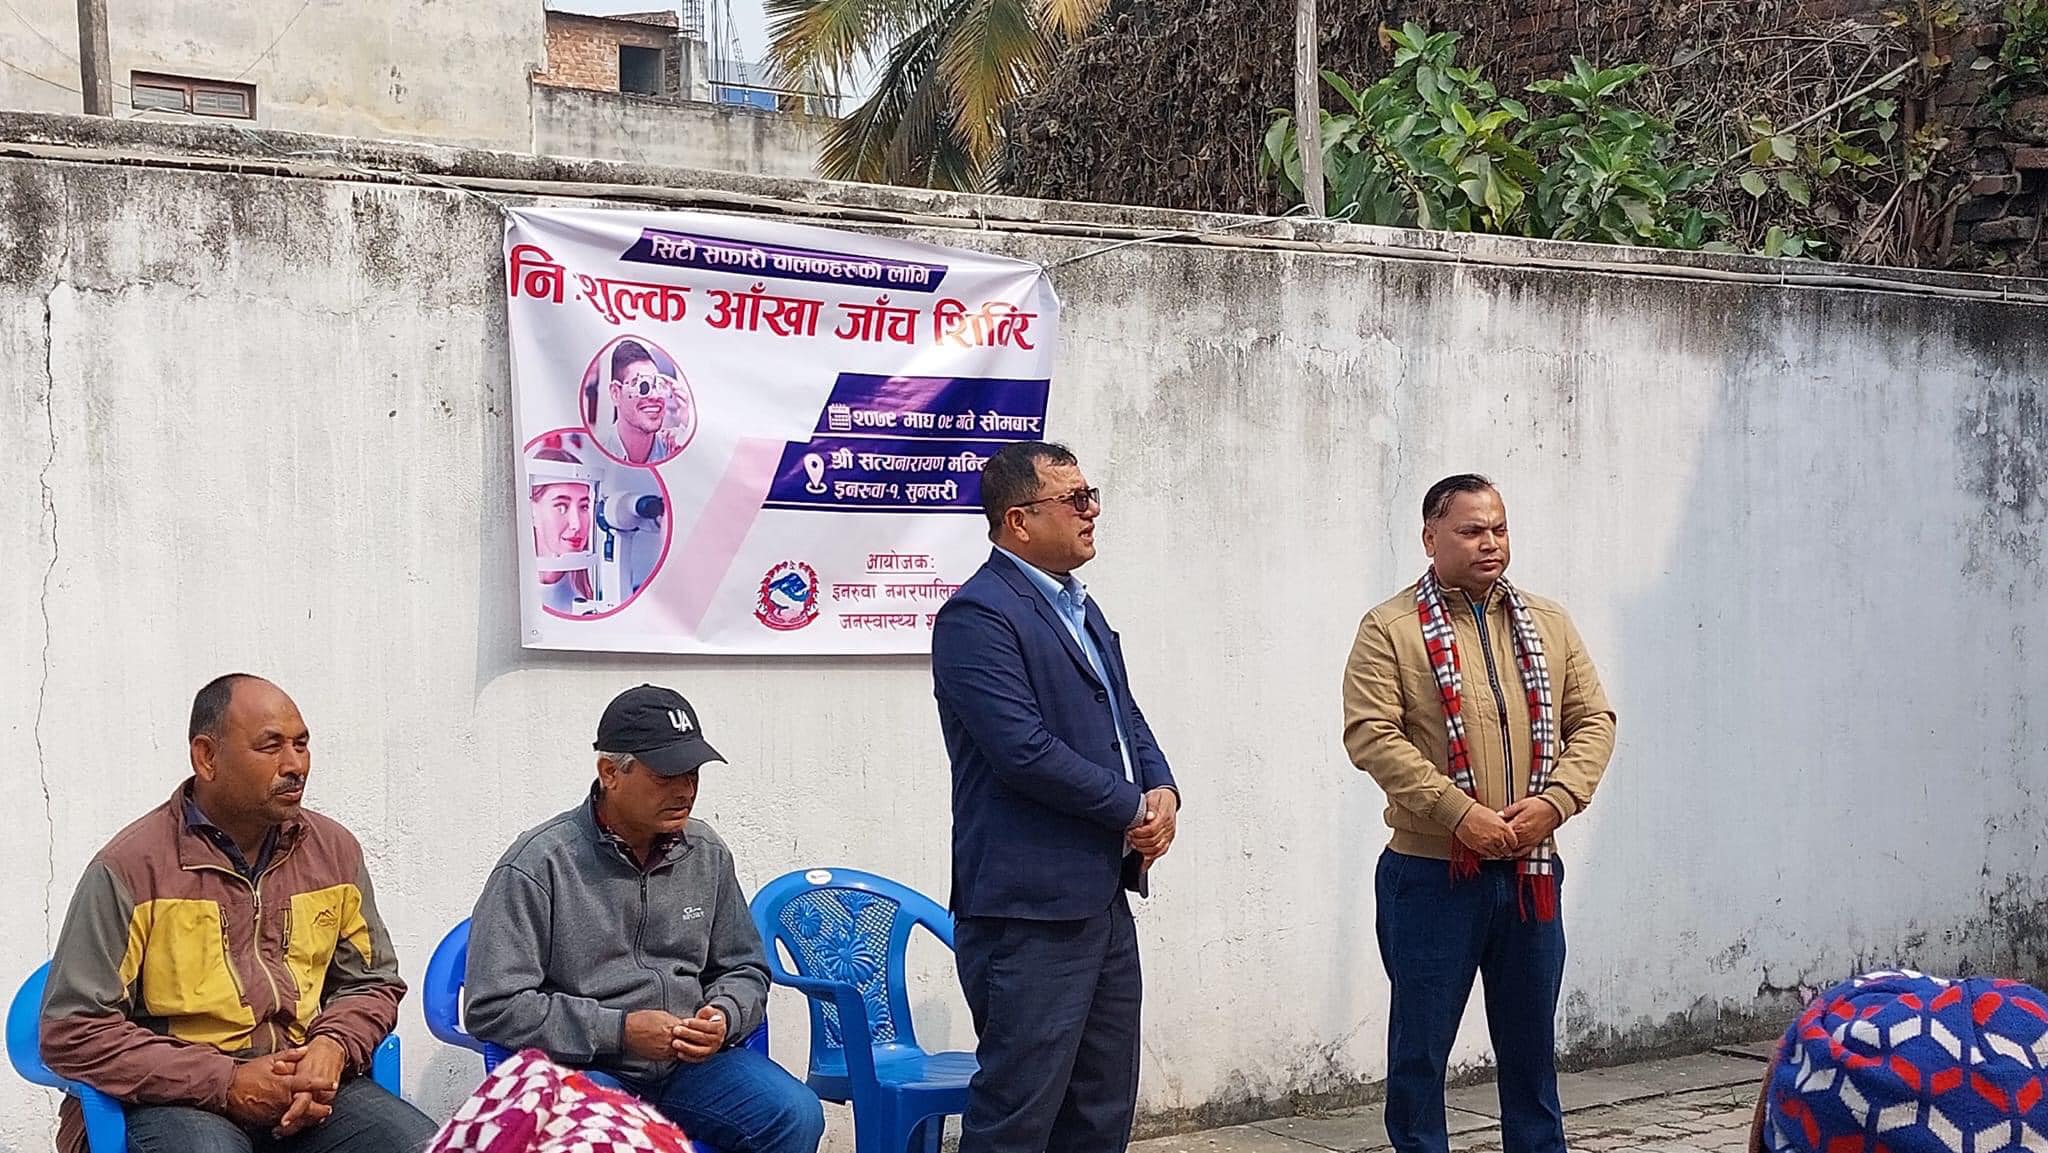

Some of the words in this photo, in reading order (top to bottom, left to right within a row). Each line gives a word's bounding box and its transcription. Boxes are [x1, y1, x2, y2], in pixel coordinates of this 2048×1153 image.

[650, 234, 697, 261] सिटी
[702, 245, 767, 269] सफारी
[887, 264, 931, 285] लागि
[704, 281, 824, 337] आँखा
[834, 293, 921, 345] जाँच
[852, 409, 897, 428] २०७९
[902, 410, 936, 429] माघ
[979, 410, 1042, 433] सोमबार
[831, 447, 854, 470] श्री
[857, 452, 946, 473] सत्यनारायण
[904, 479, 958, 503] सुनसरी
